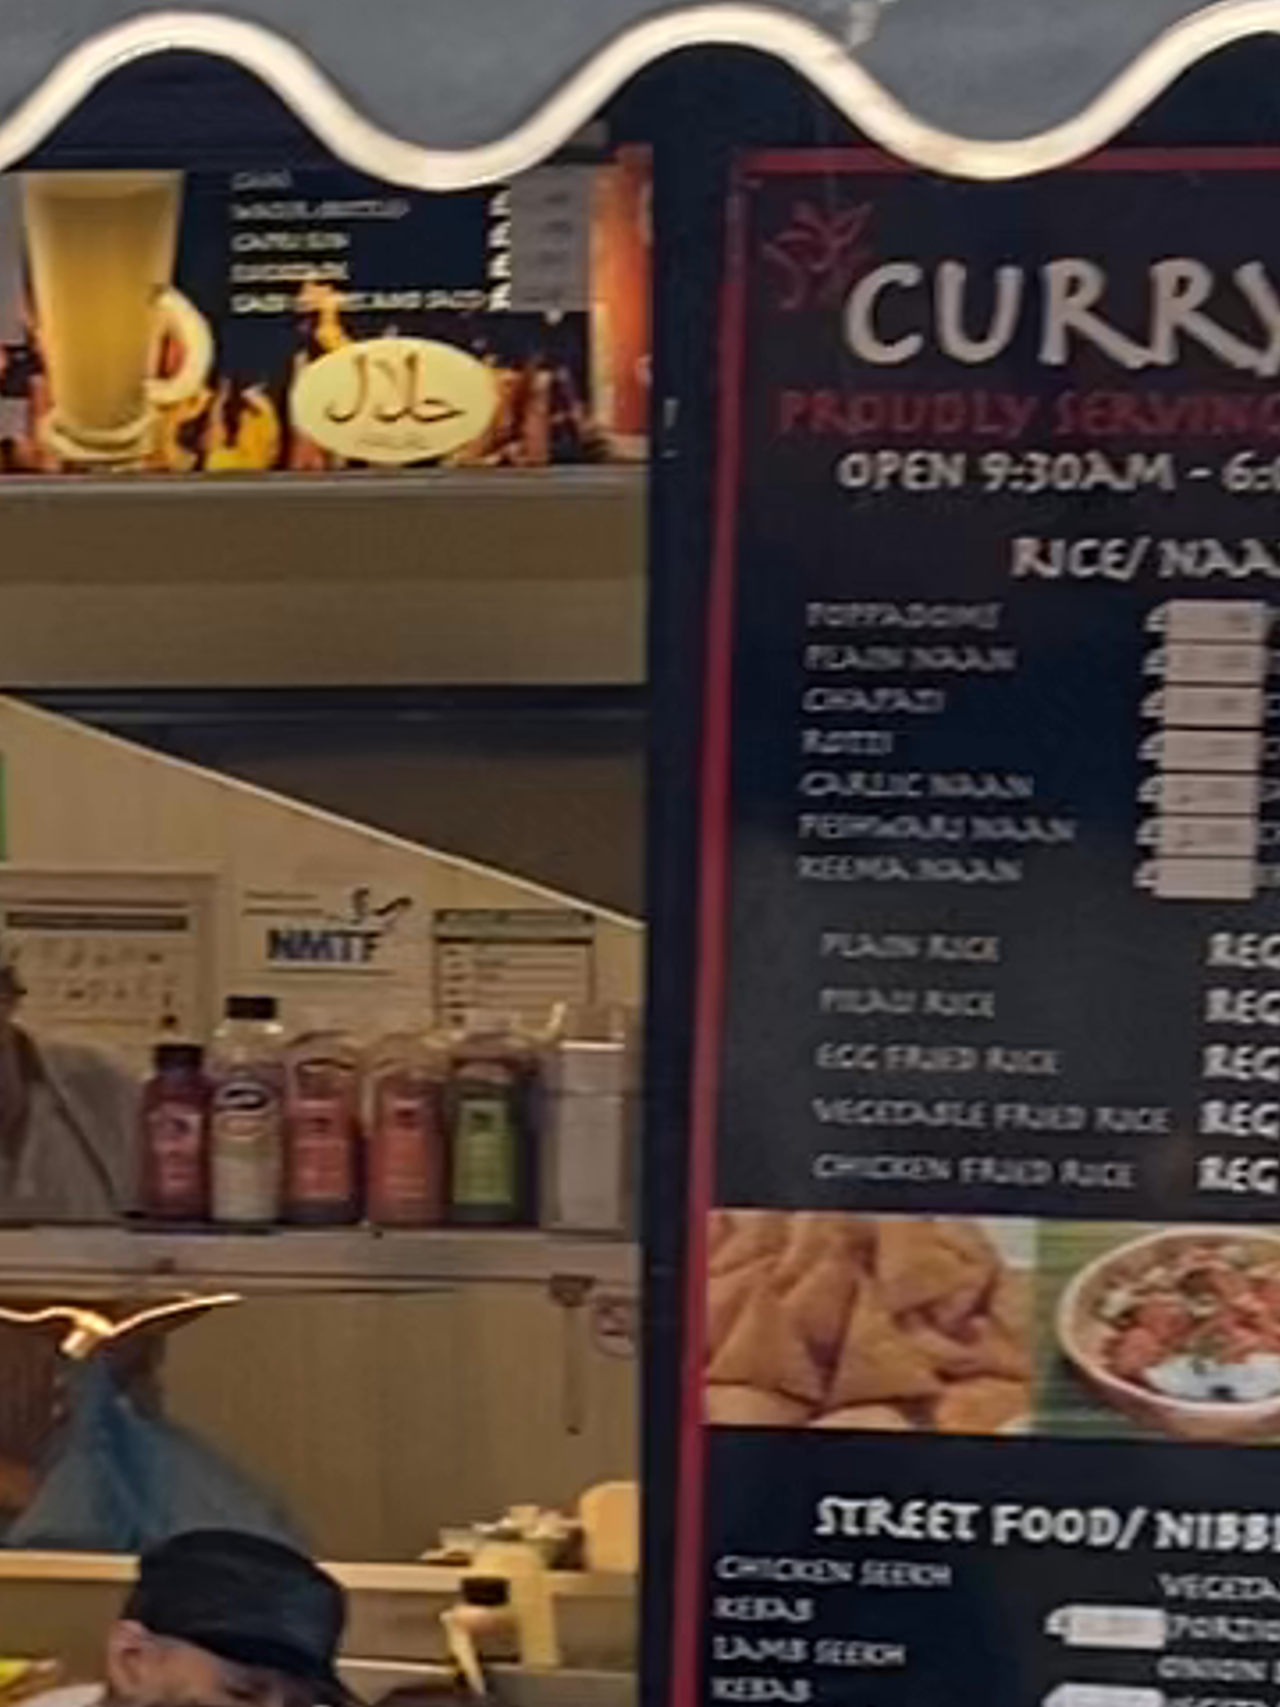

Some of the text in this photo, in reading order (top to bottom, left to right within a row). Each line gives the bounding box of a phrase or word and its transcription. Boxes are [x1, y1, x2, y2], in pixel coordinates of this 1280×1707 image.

[777, 389, 1031, 441] PROUDLY
[836, 450, 968, 492] OPEN
[980, 450, 1177, 493] 9:30AM
[1010, 534, 1152, 581] RICE/
[910, 645, 1019, 672] NAAN
[929, 773, 1034, 799] NAAN
[925, 934, 1000, 962] RICE
[923, 990, 996, 1018] RICE
[984, 1047, 1062, 1076] RICE
[1094, 1105, 1173, 1134] RICE
[1198, 1099, 1280, 1140] REG
[1060, 1159, 1137, 1188] RICE
[1196, 1155, 1280, 1195] REG
[814, 1494, 982, 1541] STREET
